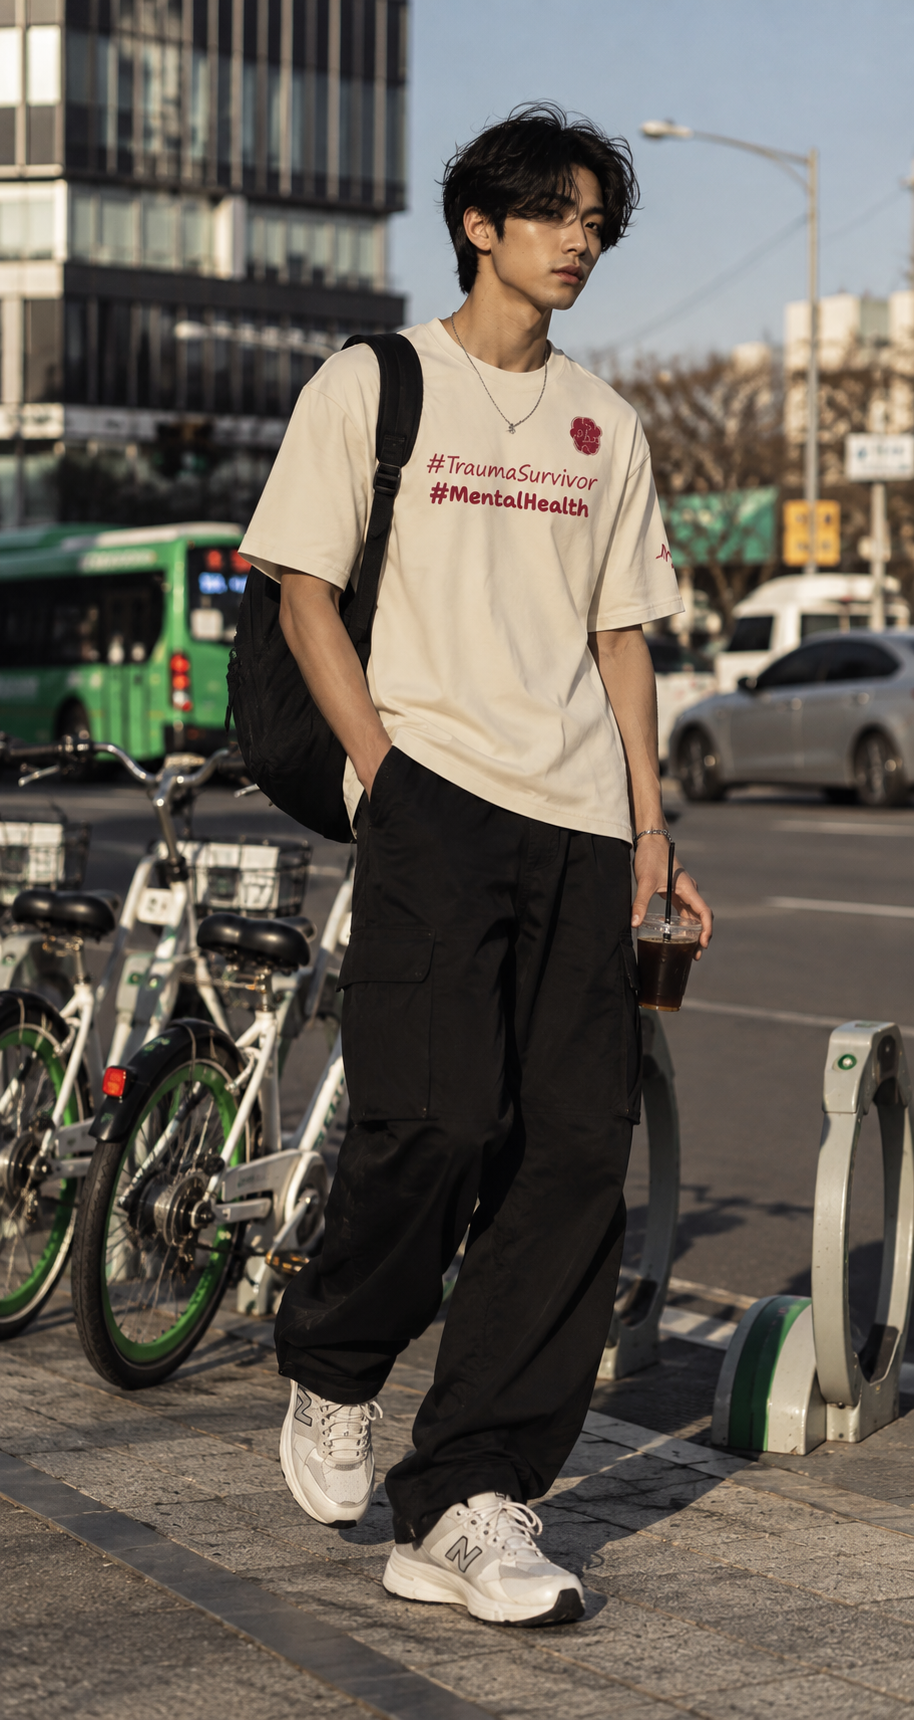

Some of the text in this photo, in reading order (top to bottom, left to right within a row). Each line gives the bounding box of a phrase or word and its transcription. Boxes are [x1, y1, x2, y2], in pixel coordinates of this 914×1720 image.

[426, 453, 598, 491] #TraumaSurvivor
[429, 481, 589, 518] #MentalHealth
[445, 1535, 483, 1573] N
